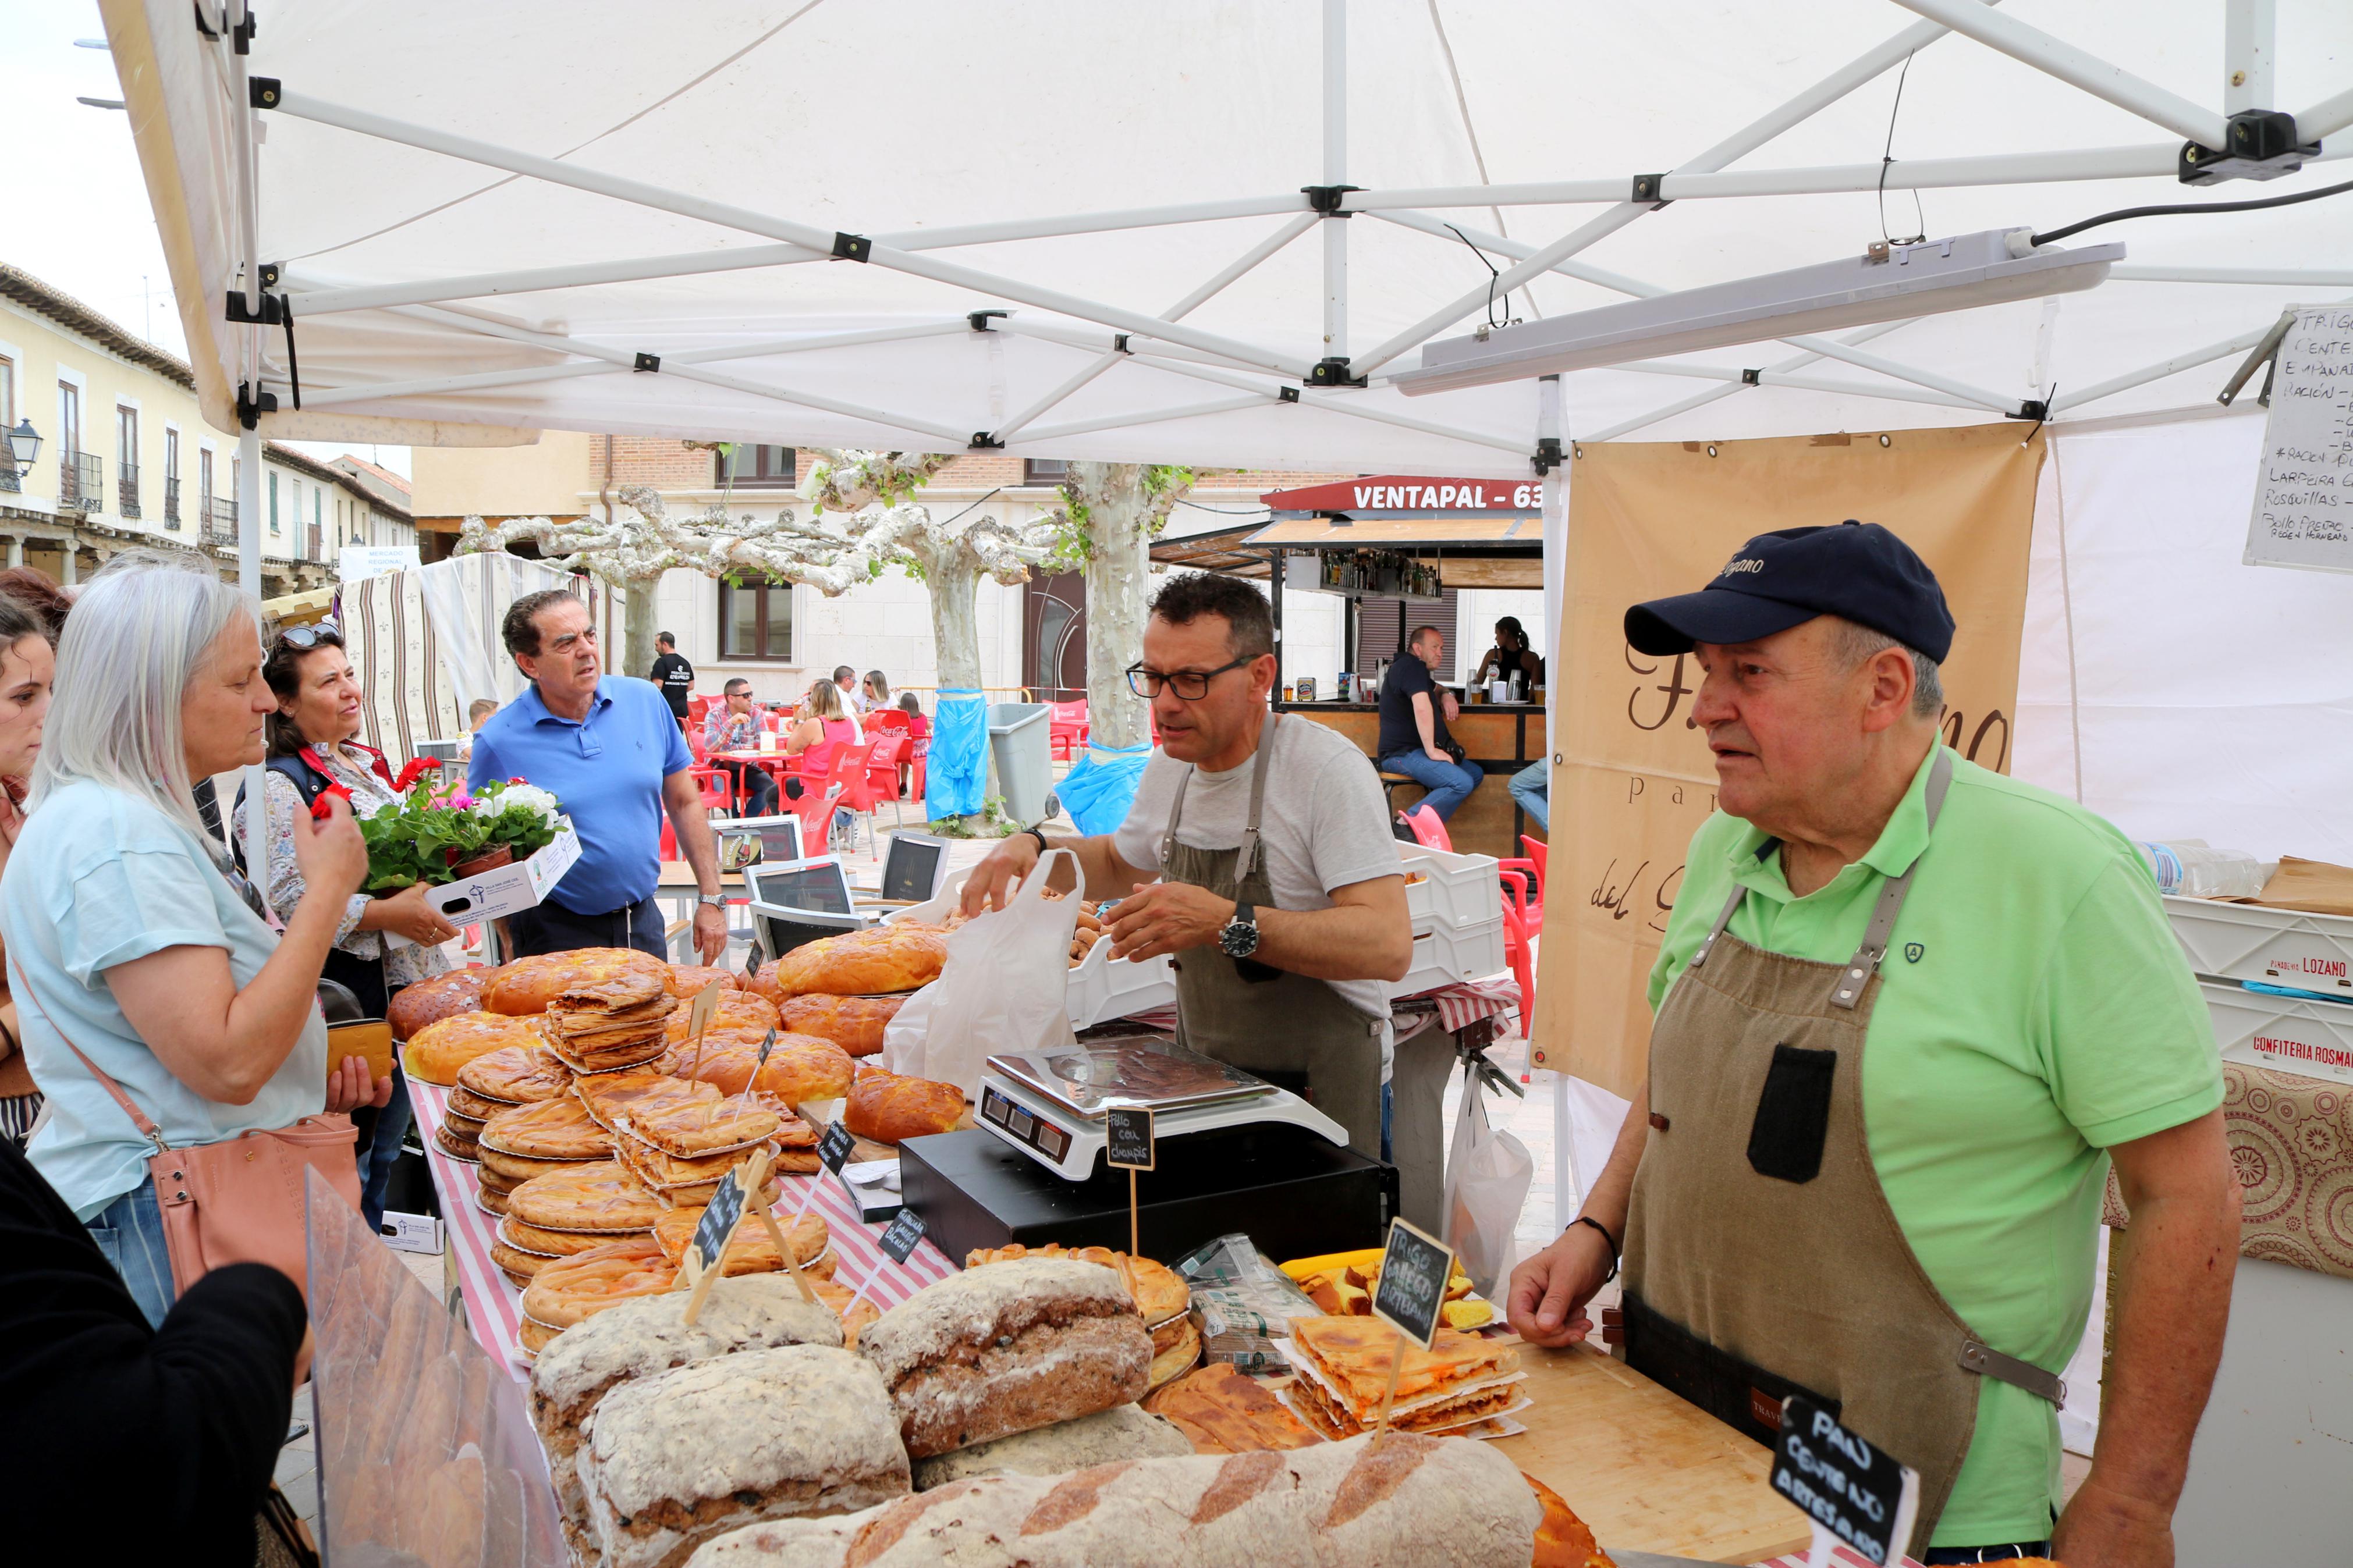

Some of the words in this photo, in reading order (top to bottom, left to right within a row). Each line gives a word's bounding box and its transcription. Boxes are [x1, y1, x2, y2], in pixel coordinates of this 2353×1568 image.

[2295, 338, 2353, 354] CENTE
[1353, 486, 1487, 509] VENTAPAL
[2303, 958, 2346, 977] LOZANO
[2253, 1036, 2313, 1060] CONFITERIA
[1108, 1114, 1130, 1128] Pollo
[1111, 1145, 1148, 1164] champis
[1811, 1409, 1872, 1470] PAN
[1776, 1467, 1885, 1566] ARTESANO
